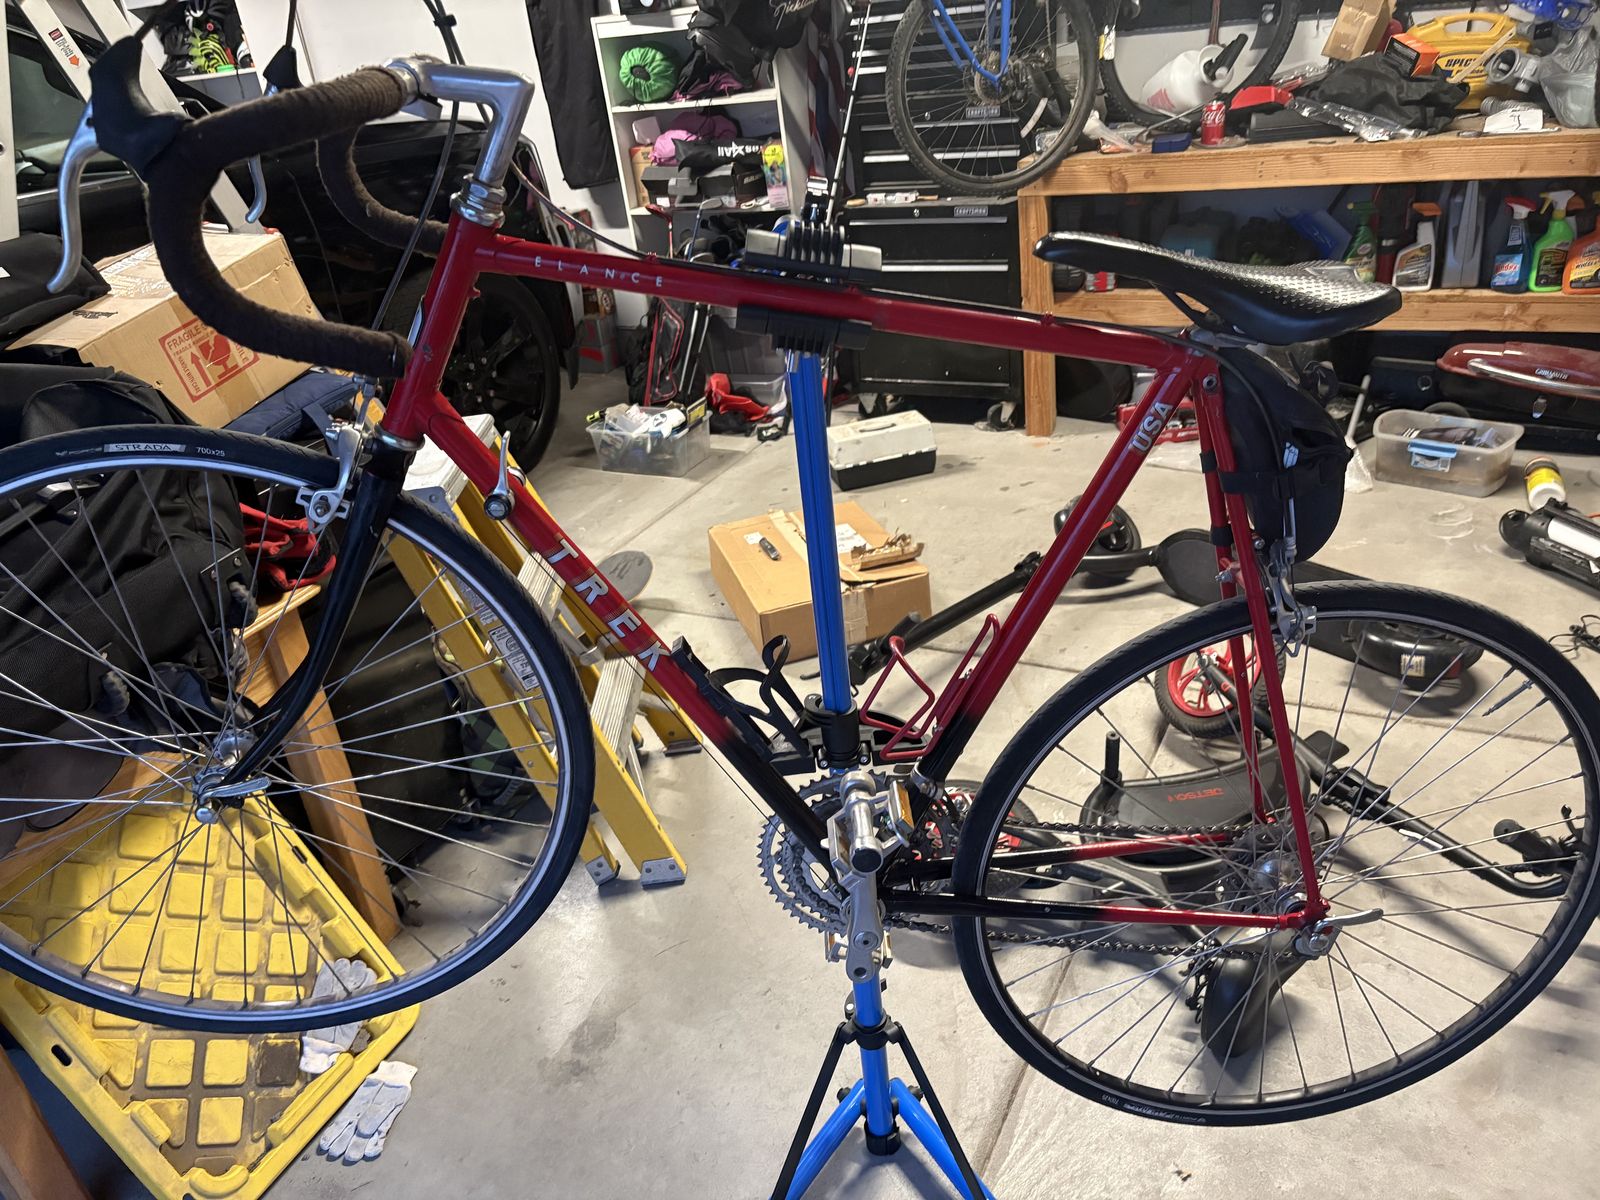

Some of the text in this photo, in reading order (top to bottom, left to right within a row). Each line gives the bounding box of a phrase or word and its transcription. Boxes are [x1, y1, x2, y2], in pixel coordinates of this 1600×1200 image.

[534, 256, 663, 287] ELANCE
[167, 324, 202, 351] FRAGILE
[1132, 402, 1173, 451] USA
[115, 444, 172, 452] STRADA
[547, 538, 671, 672] TREK
